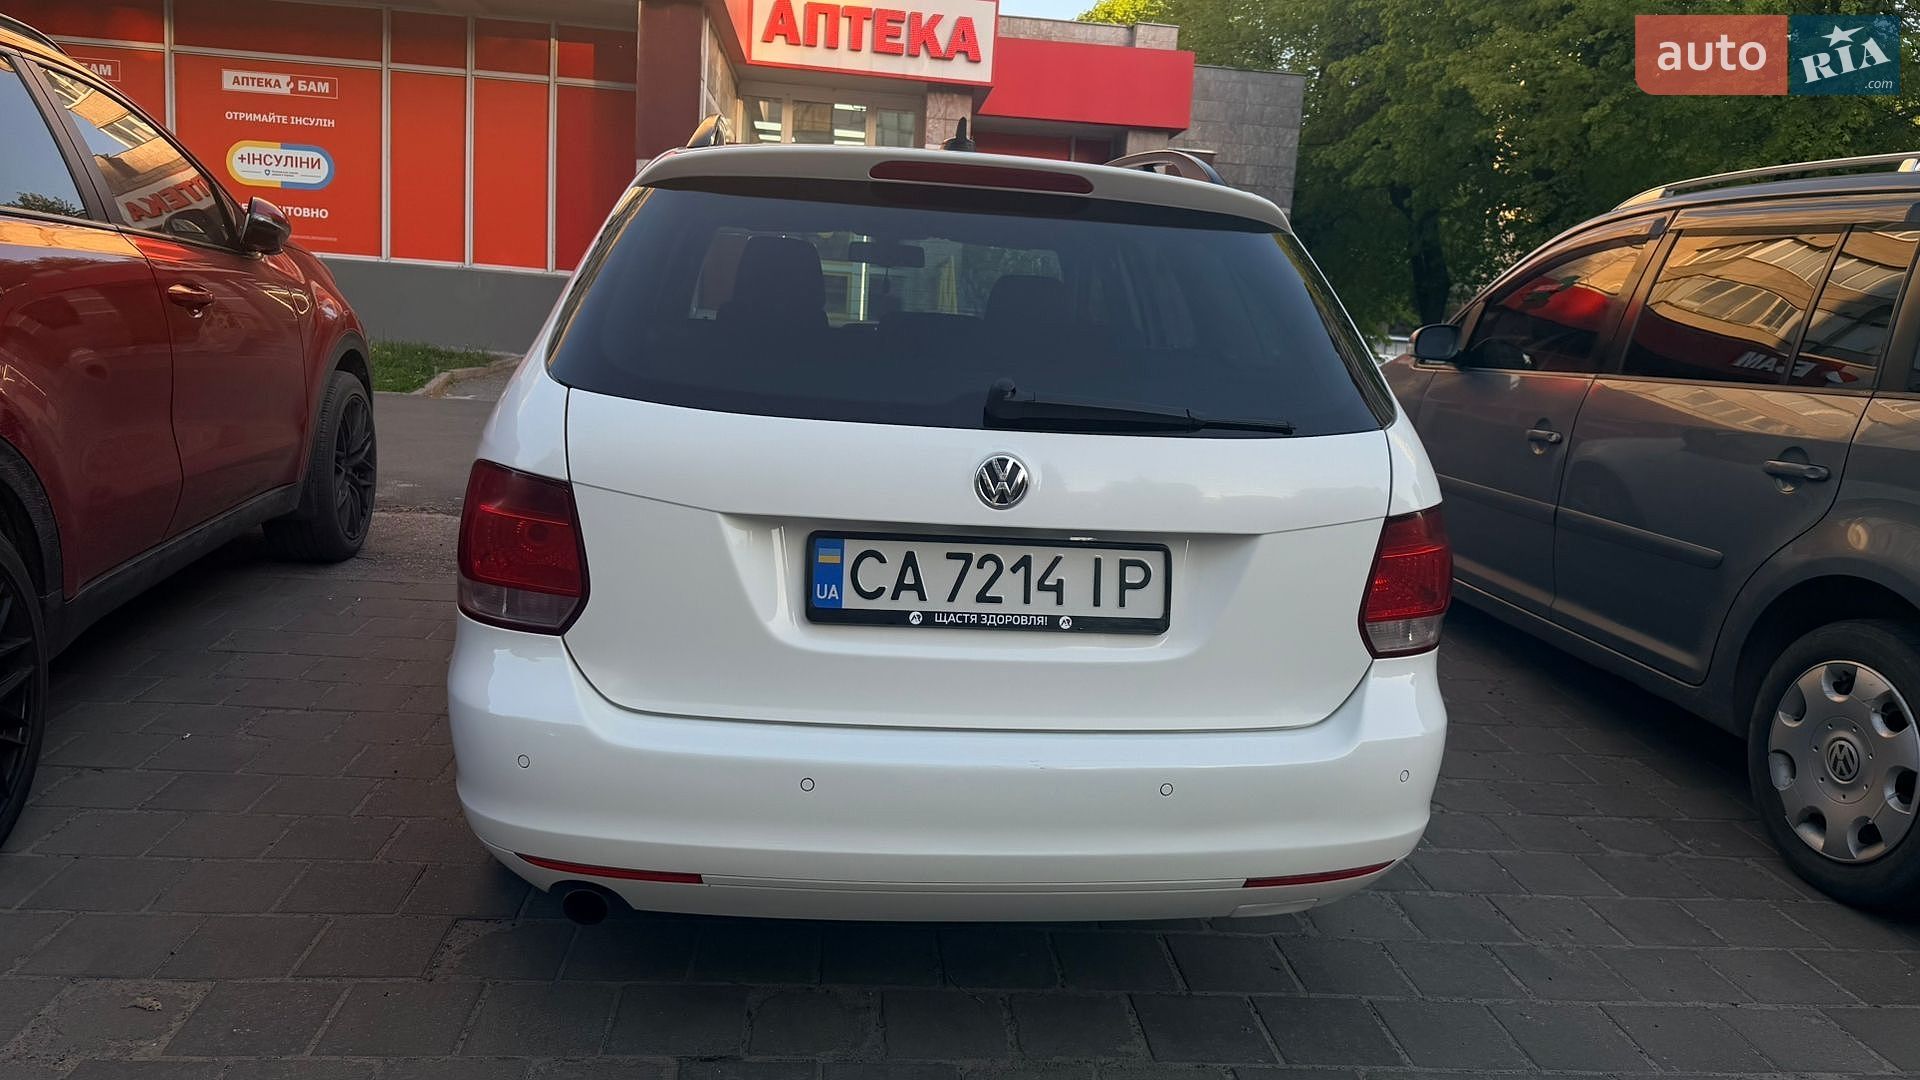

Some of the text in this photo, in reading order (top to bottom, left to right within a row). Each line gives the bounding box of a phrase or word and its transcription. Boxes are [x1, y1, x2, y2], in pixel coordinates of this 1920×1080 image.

[761, 0, 982, 63] АПТЕКА
[232, 75, 329, 93] АПТЕКА БАМ
[225, 111, 335, 127] ОТРИМАЙТЕ ІНСУЛІН
[238, 152, 321, 169] +ІНСУЛІНИ
[850, 549, 1152, 608] CA 7214 IP
[816, 583, 839, 600] UA
[934, 612, 978, 625] ЩАСТЯ
[980, 614, 1048, 627] ЗДОРОВЛЯ!
